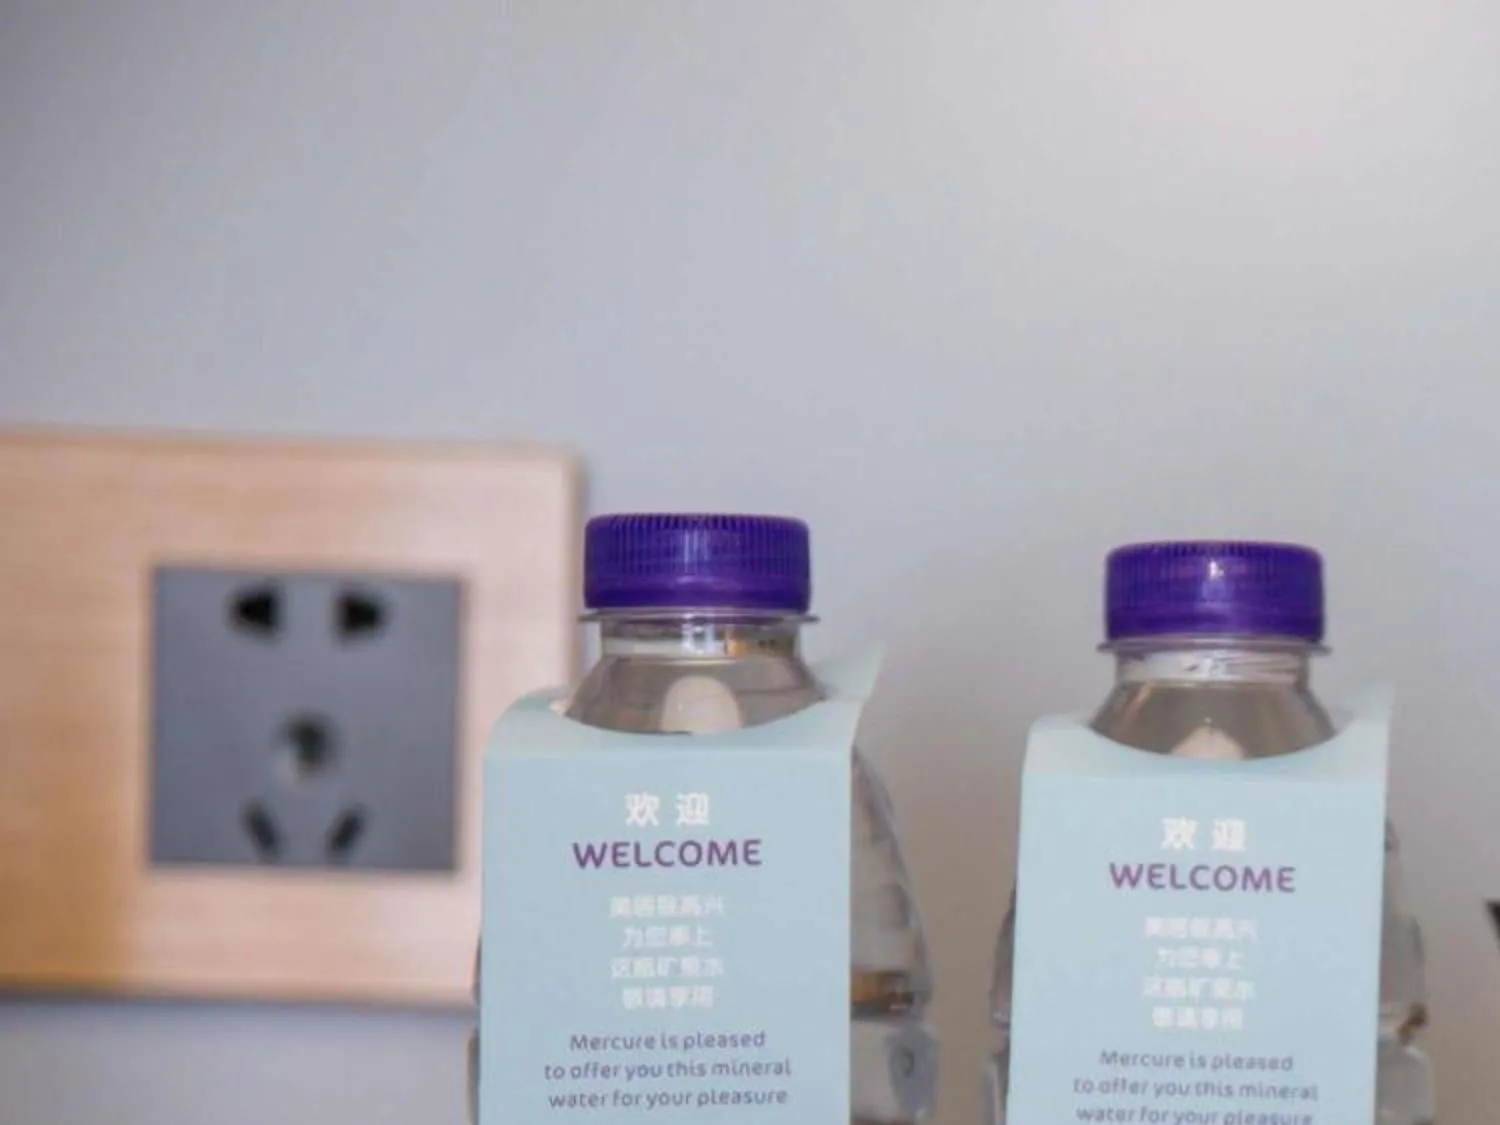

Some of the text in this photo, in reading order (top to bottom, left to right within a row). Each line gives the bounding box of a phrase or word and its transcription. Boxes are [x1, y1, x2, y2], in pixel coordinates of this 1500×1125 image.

[624, 792, 710, 827] 欢迎
[573, 838, 762, 870] WELCOME
[1109, 862, 1297, 893] WELCOME
[570, 1030, 766, 1052] Mercure is pleased
[544, 1058, 792, 1082] to offer you this mineral
[1099, 1051, 1294, 1072] Mercure is pleased
[549, 1088, 788, 1111] water for your pleasure
[1073, 1077, 1318, 1102] to offer you this mineral
[1076, 1107, 1136, 1123] water
[1140, 1105, 1169, 1123] for
